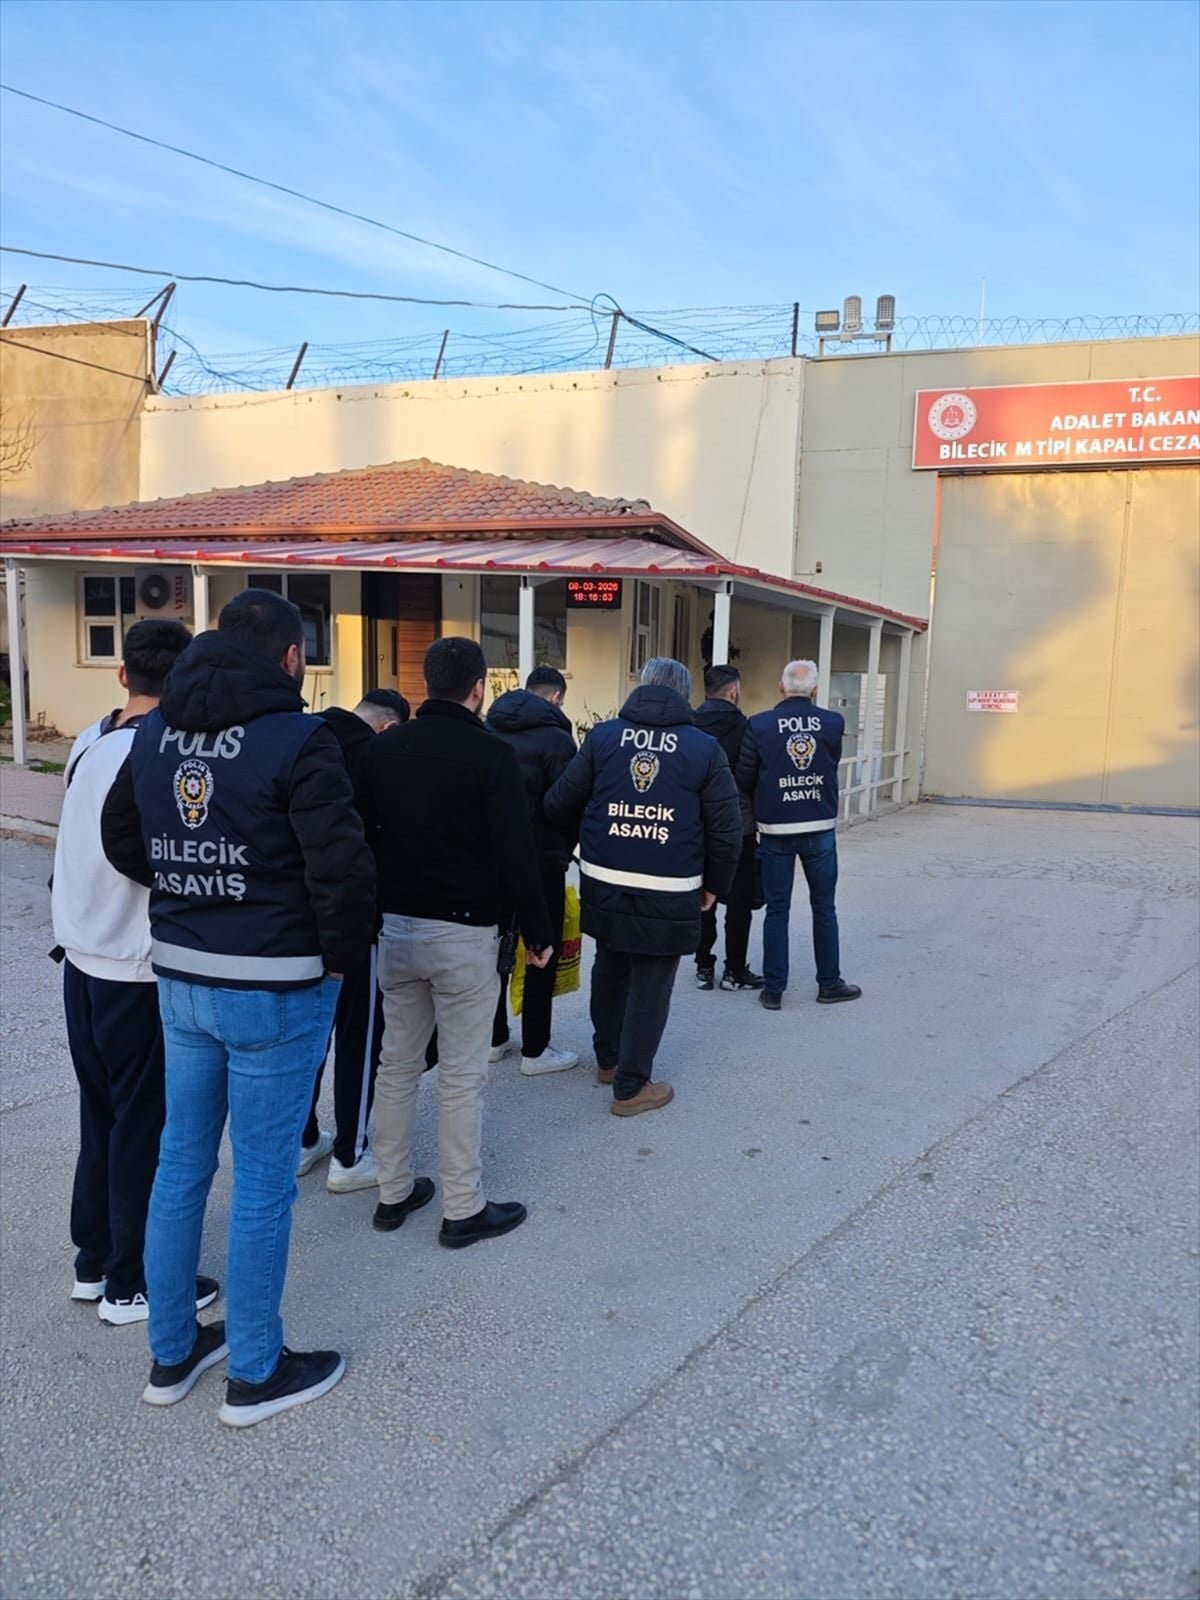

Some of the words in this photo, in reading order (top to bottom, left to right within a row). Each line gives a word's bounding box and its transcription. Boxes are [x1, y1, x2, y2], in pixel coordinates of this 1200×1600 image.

[1129, 387, 1161, 402] T.C.
[1050, 412, 1126, 430] ADALET
[940, 441, 1007, 459] BİLECİK
[1016, 441, 1031, 456] M
[1036, 437, 1070, 454] TİPİ
[1076, 437, 1143, 453] KAPALI
[779, 773, 824, 787] BİLECİK
[783, 788, 821, 801] ASAYİŞ
[608, 800, 674, 821] BİLECİK
[609, 823, 669, 844] ASAYİŞ
[152, 833, 249, 866] BİLECİK
[157, 870, 246, 901] ASAYİŞ
